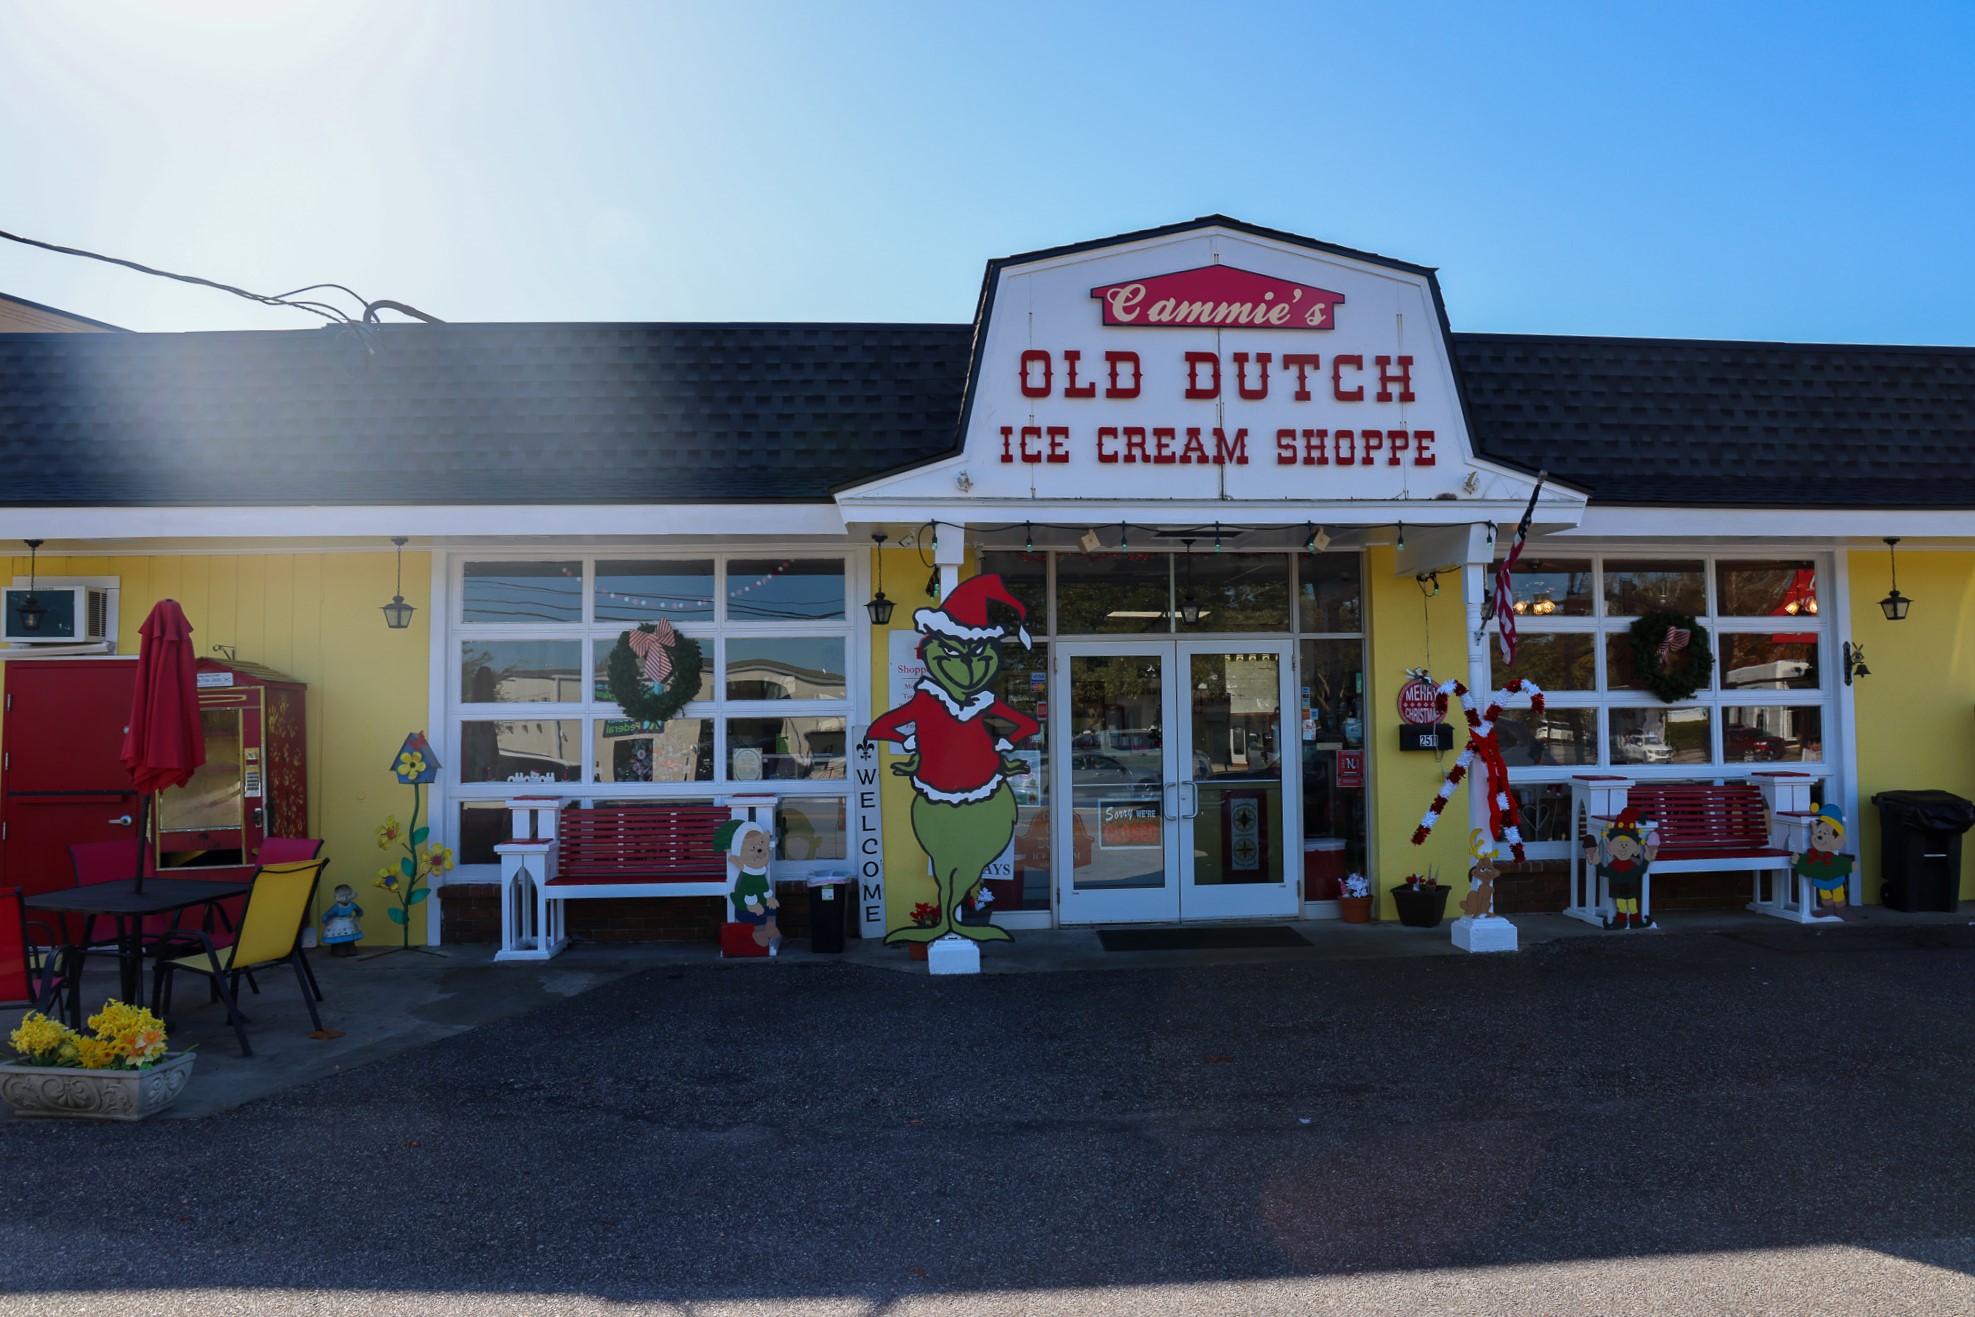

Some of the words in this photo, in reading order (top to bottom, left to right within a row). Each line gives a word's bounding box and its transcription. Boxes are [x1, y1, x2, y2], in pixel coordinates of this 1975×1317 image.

[1107, 283, 1327, 326] Cammie's
[1018, 349, 1142, 398] OLD
[1184, 351, 1416, 402] DUTCH
[1000, 426, 1070, 463] ICE
[1096, 427, 1249, 465] CREAM
[1276, 429, 1436, 466] SHOPPE
[897, 664, 928, 676] Shopp
[1406, 683, 1439, 701] MERRY
[1105, 806, 1134, 822] Sorry
[1136, 809, 1156, 818] WE'RE
[1104, 824, 1158, 842] CLOSED
[856, 768, 882, 922] WELCOME
[984, 863, 1011, 876] AYS
